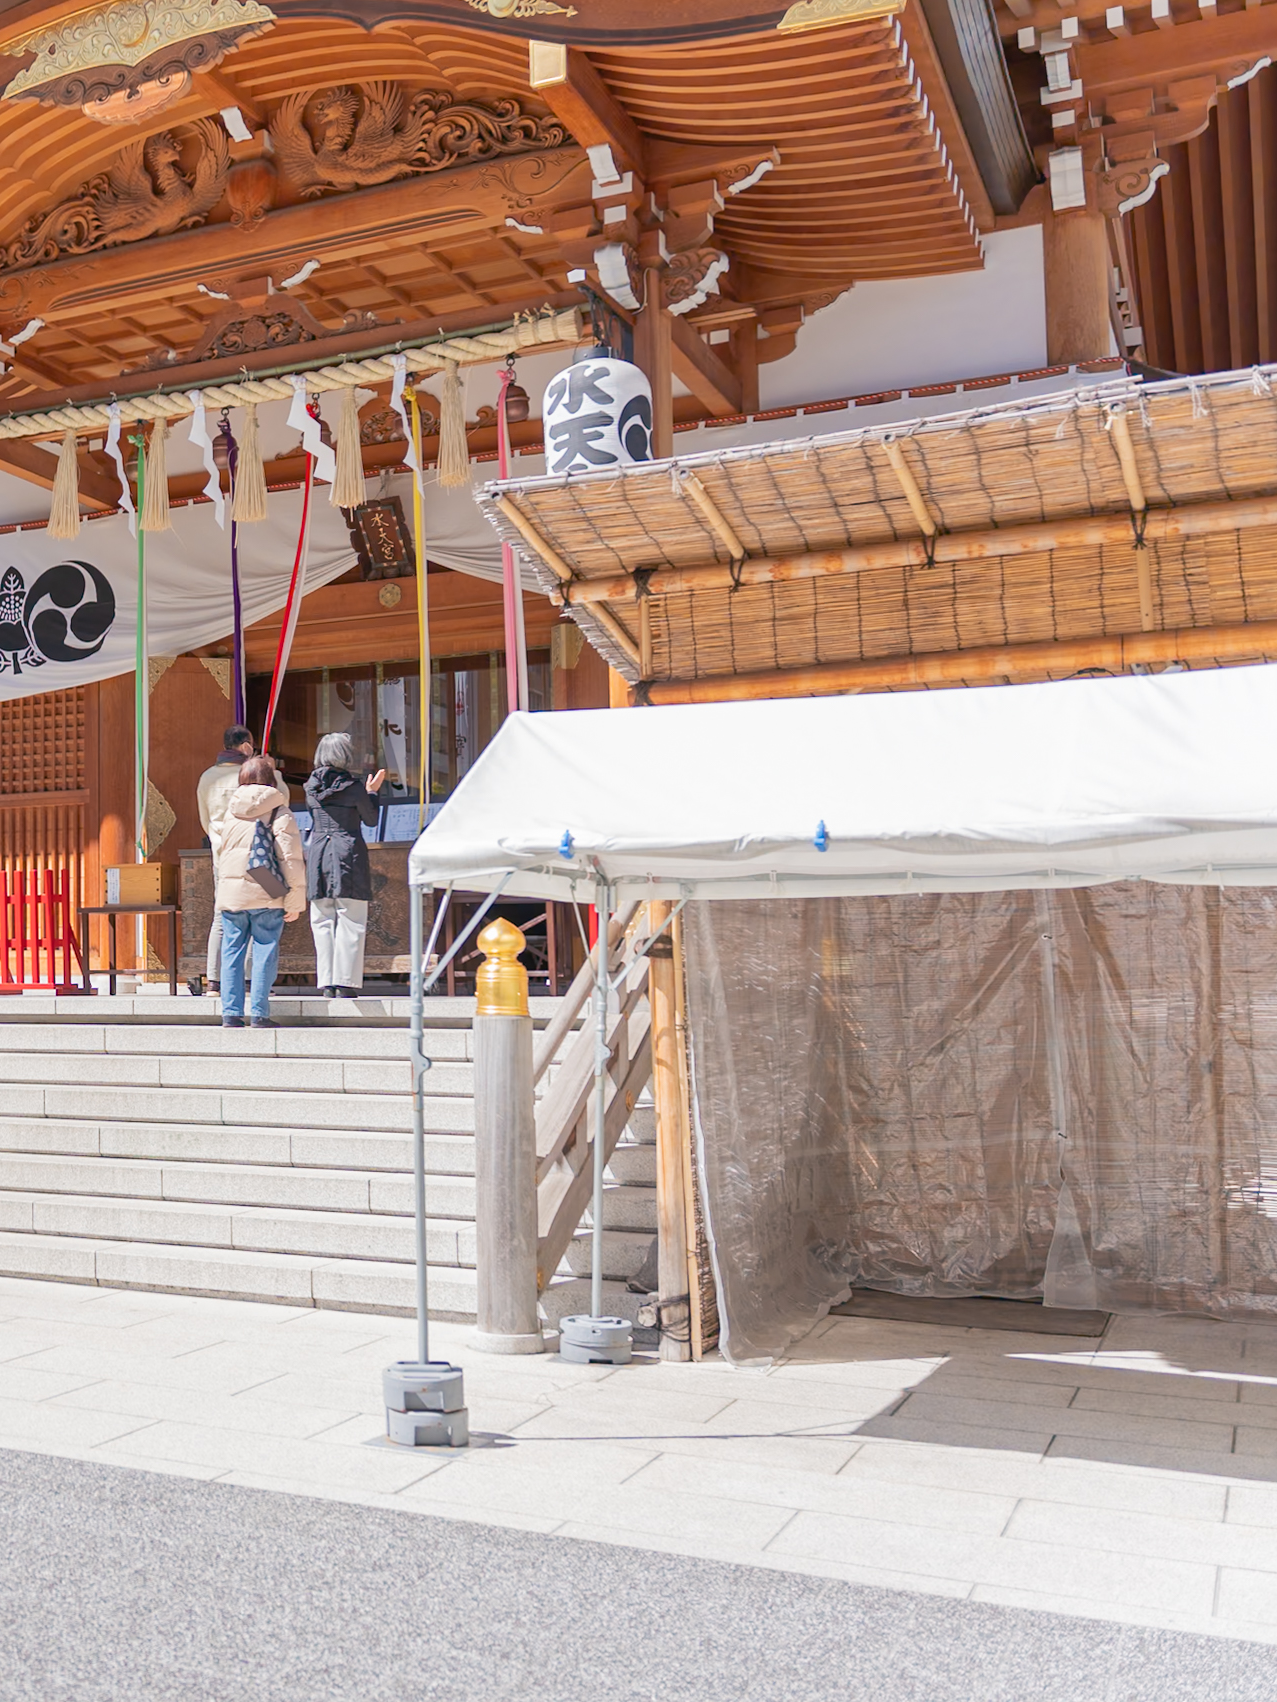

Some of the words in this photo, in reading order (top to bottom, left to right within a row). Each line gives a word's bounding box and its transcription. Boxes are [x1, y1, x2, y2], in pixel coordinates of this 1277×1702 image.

[547, 365, 618, 474] 水天
[370, 513, 395, 560] 水天宮
